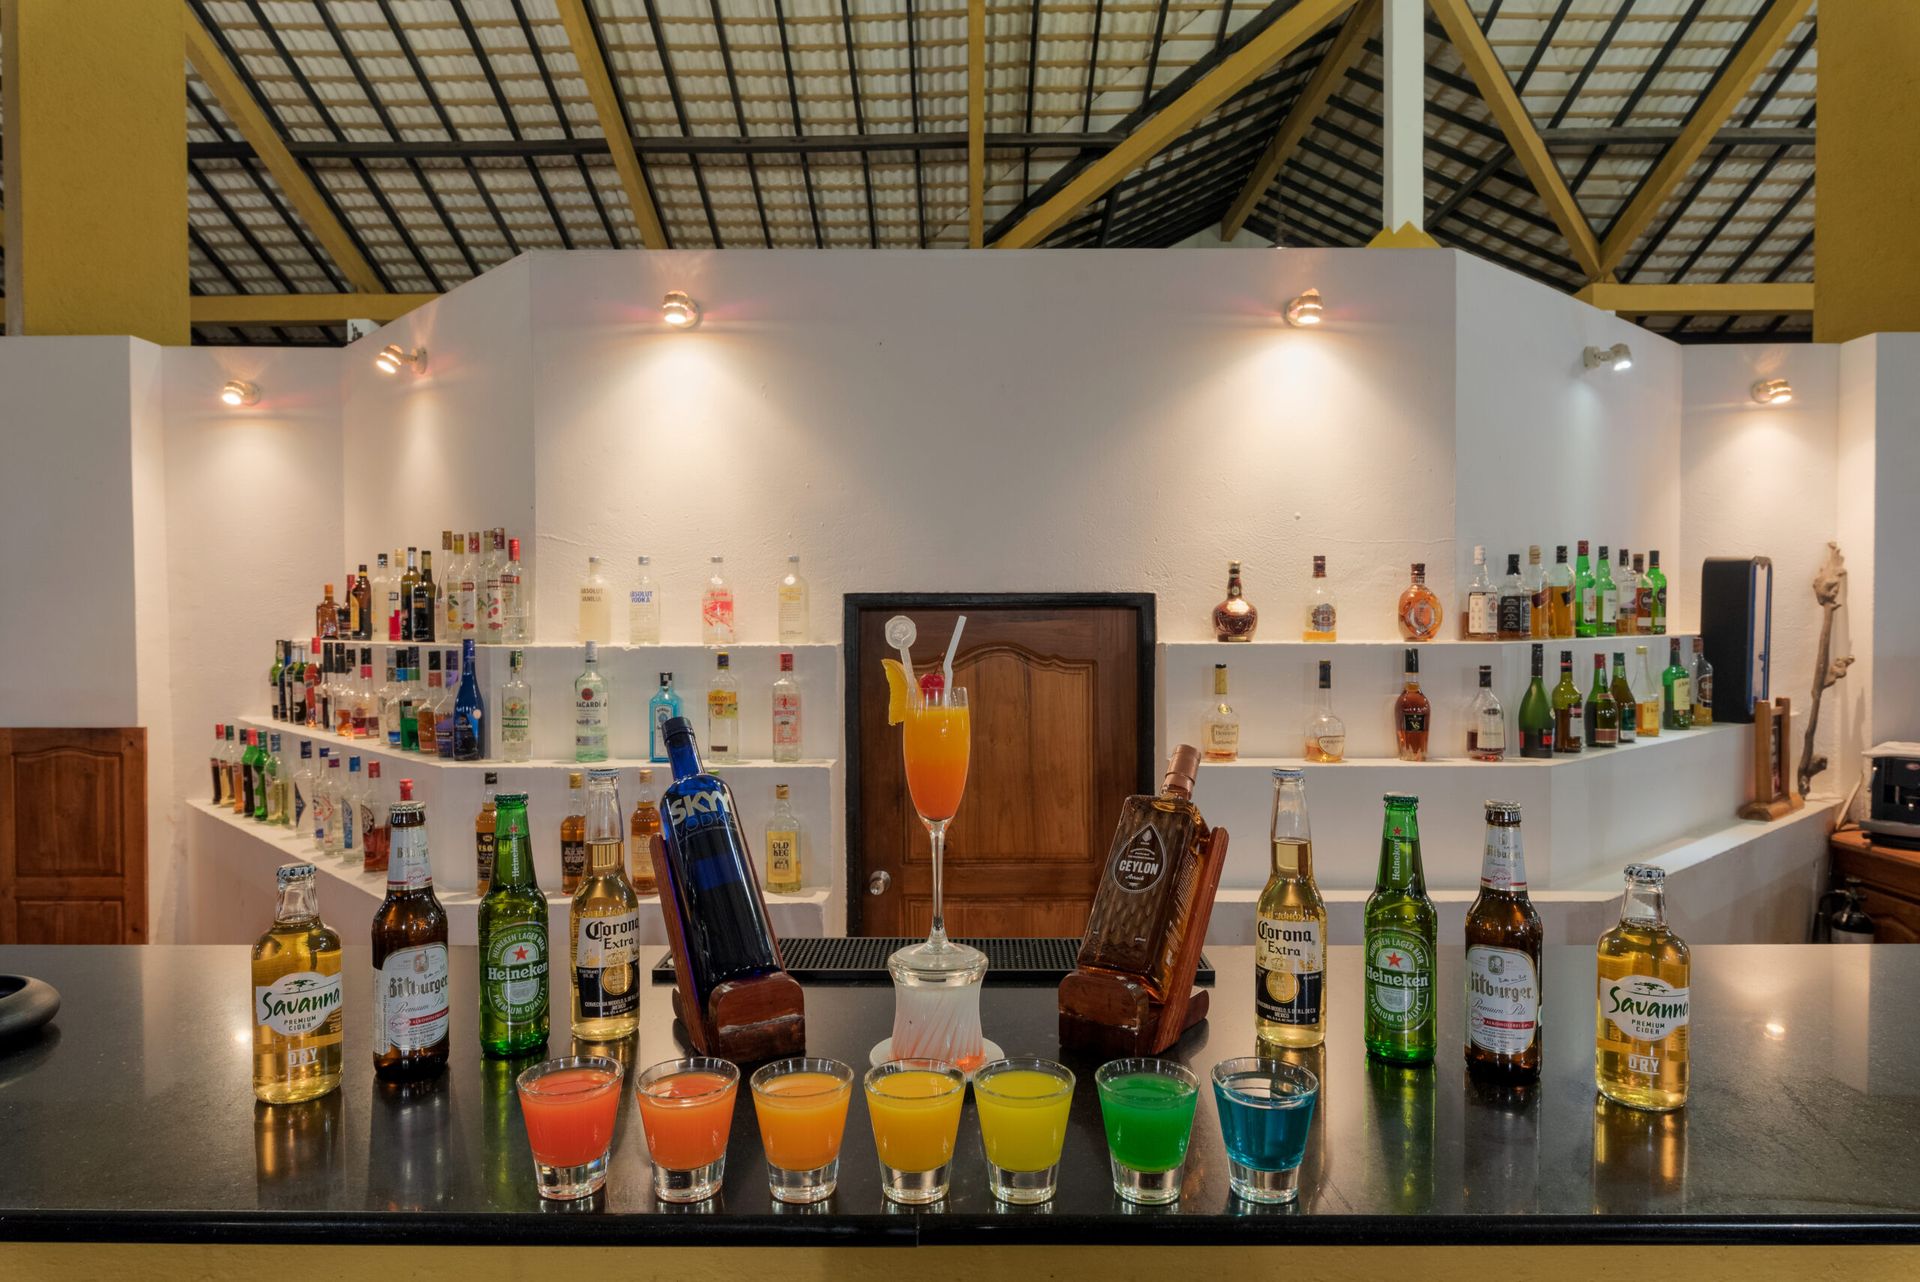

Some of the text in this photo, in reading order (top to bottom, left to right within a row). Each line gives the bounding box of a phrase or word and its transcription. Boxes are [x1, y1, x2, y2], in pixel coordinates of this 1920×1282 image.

[671, 790, 732, 825] SKYY
[773, 841, 789, 849] OLD
[1119, 860, 1159, 876] CEYLON
[1258, 920, 1313, 943] Corona
[604, 937, 634, 950] Extra
[1268, 941, 1301, 957] Extra
[488, 961, 548, 981] Heineken
[1367, 965, 1429, 987] Heineken
[262, 986, 341, 1021] Savanna
[283, 1015, 317, 1026] PREMIUM
[288, 1022, 312, 1032] CIDER
[1631, 1019, 1665, 1028] PREMIUM
[1636, 1027, 1660, 1035] CIDER
[288, 1048, 318, 1065] DRY
[1629, 1056, 1659, 1072] DRY
